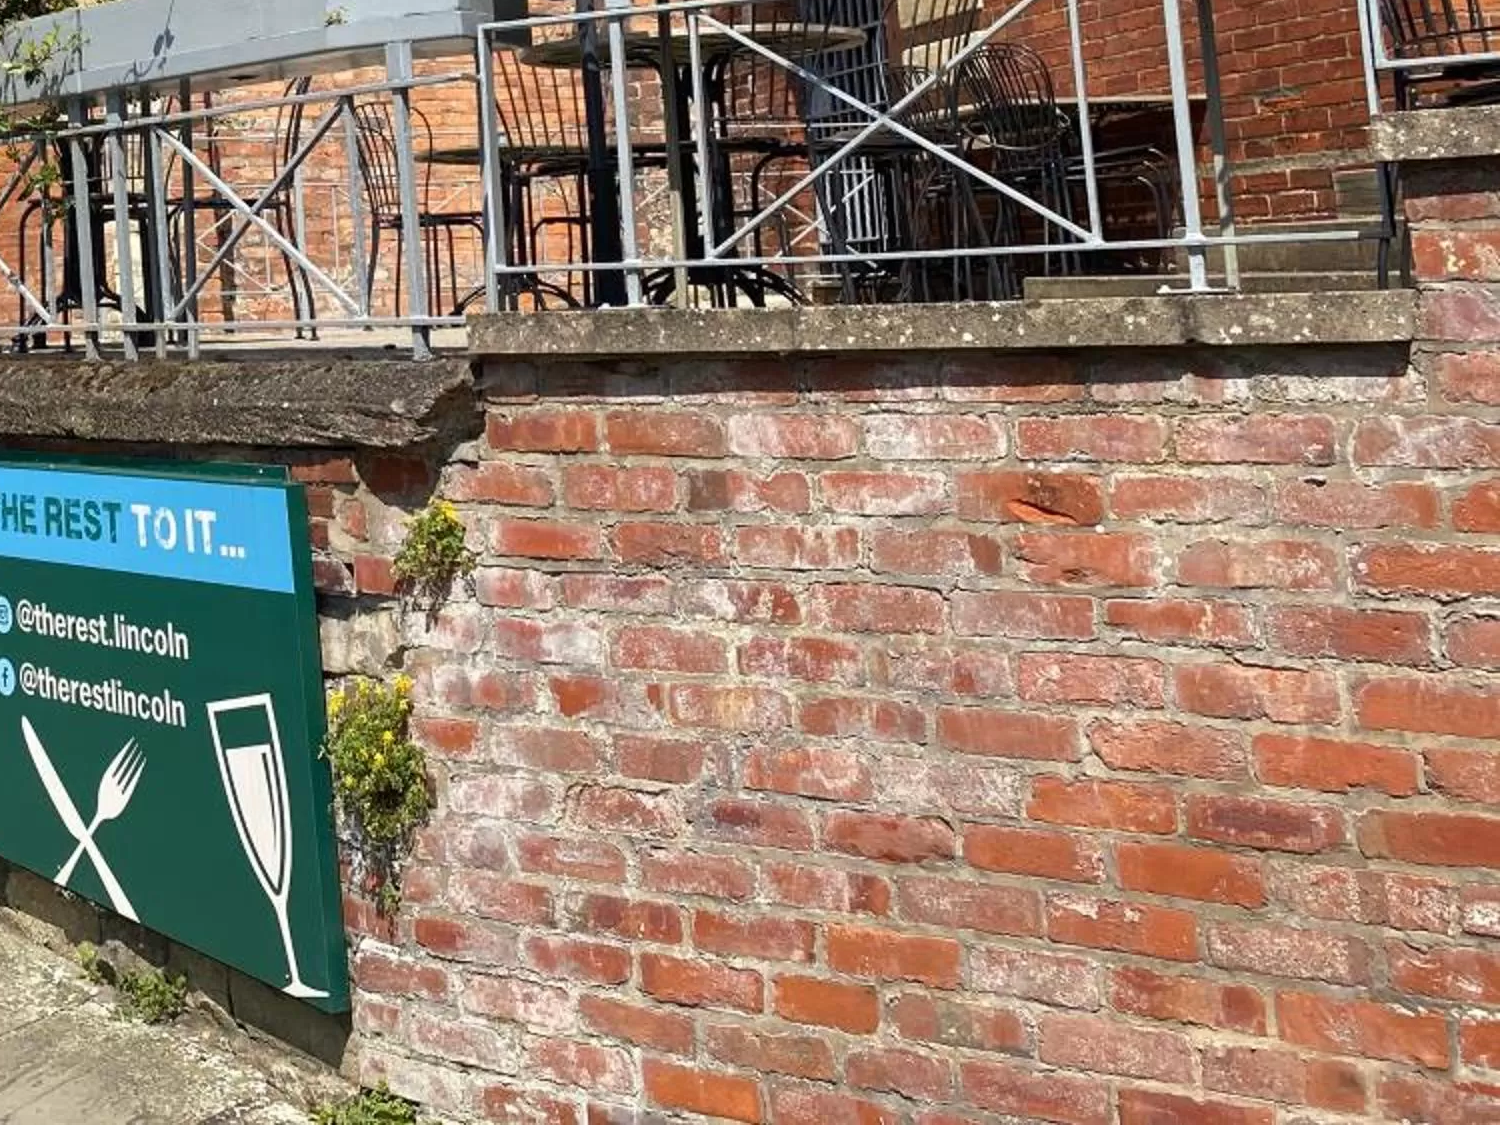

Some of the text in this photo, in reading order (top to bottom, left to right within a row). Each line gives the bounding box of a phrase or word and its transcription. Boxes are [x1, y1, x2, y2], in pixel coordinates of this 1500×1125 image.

[43, 497, 123, 543] REST
[131, 504, 178, 550] TO
[16, 599, 190, 660] @therest.lincoln
[19, 662, 187, 728] @therestlincoln
